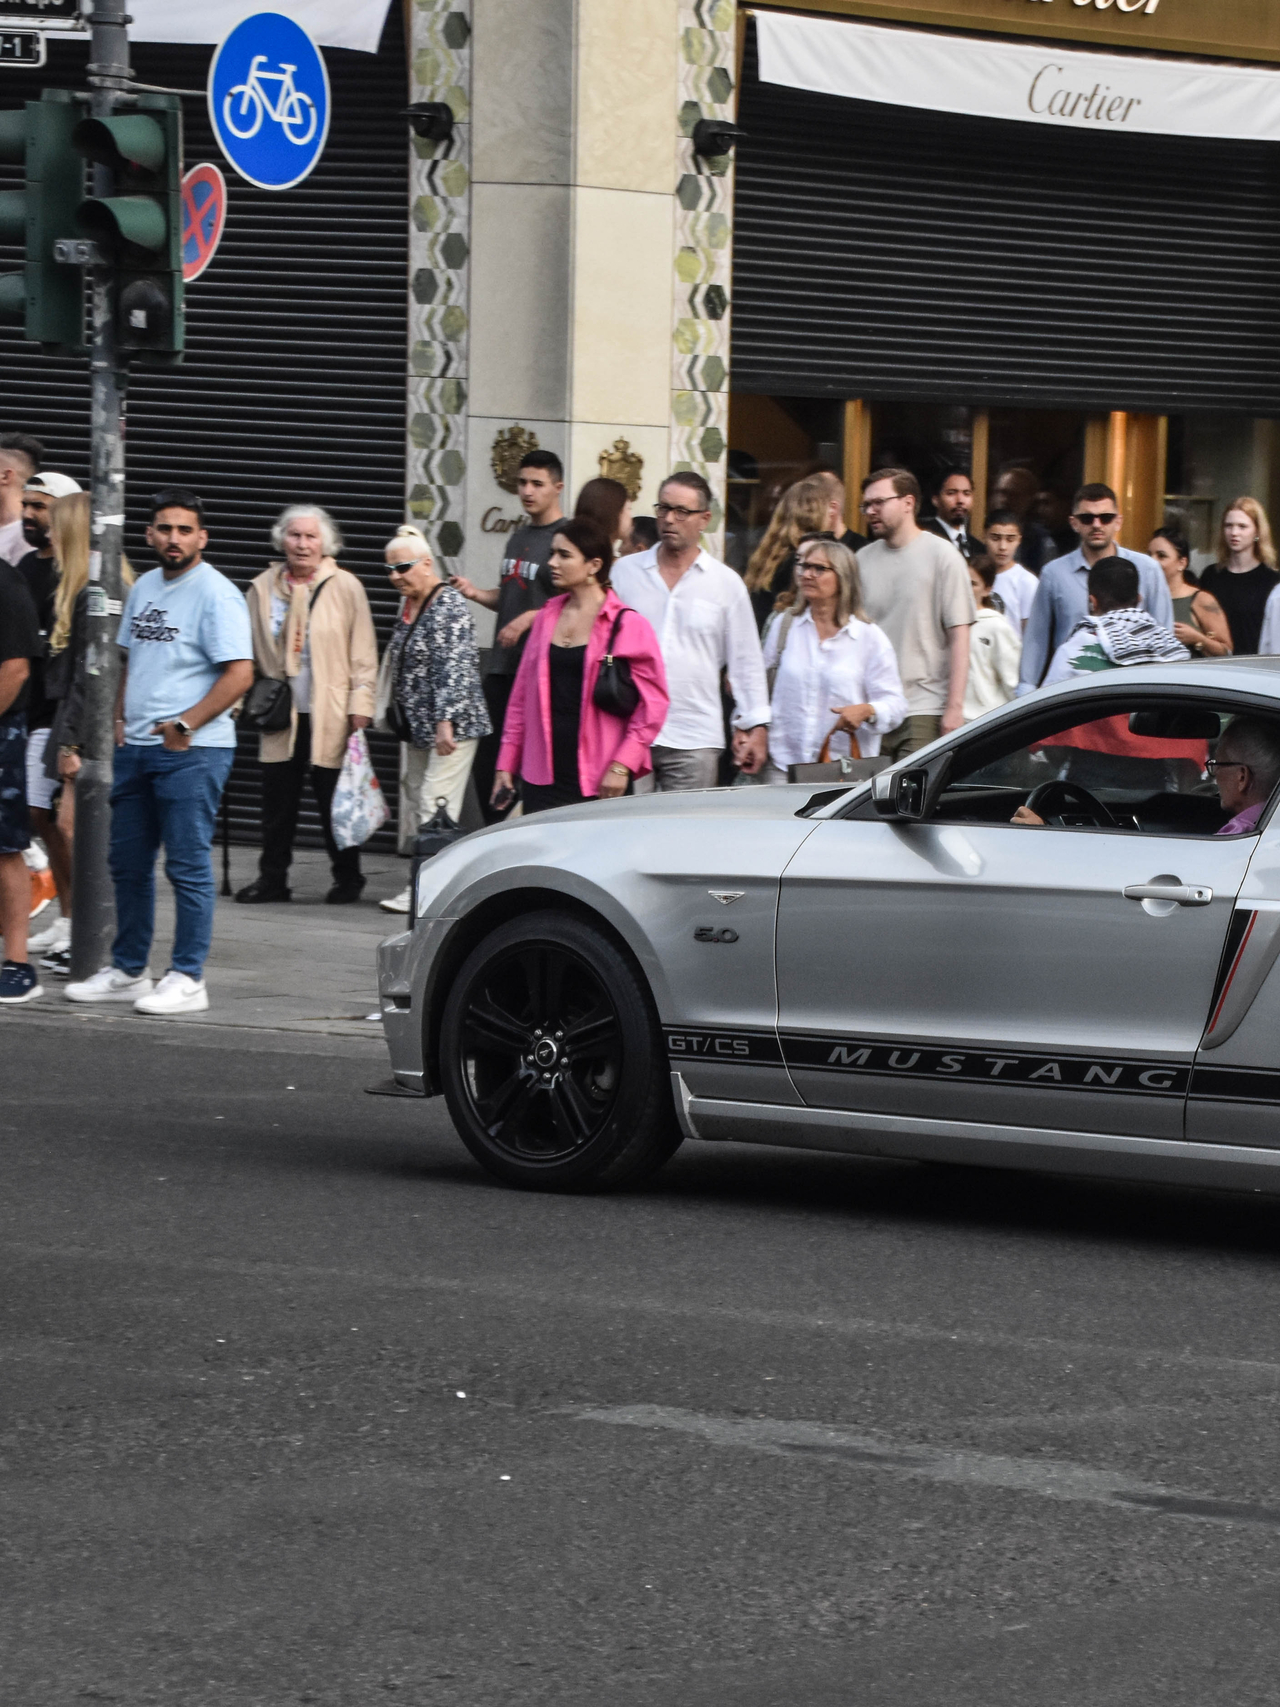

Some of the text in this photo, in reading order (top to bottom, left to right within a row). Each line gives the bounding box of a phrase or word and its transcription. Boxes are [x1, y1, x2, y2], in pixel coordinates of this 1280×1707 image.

[1028, 63, 1142, 122] Cartier
[693, 926, 739, 944] 5.0
[667, 1035, 750, 1055] GT/CS
[827, 1046, 1177, 1088] MUSTANG
